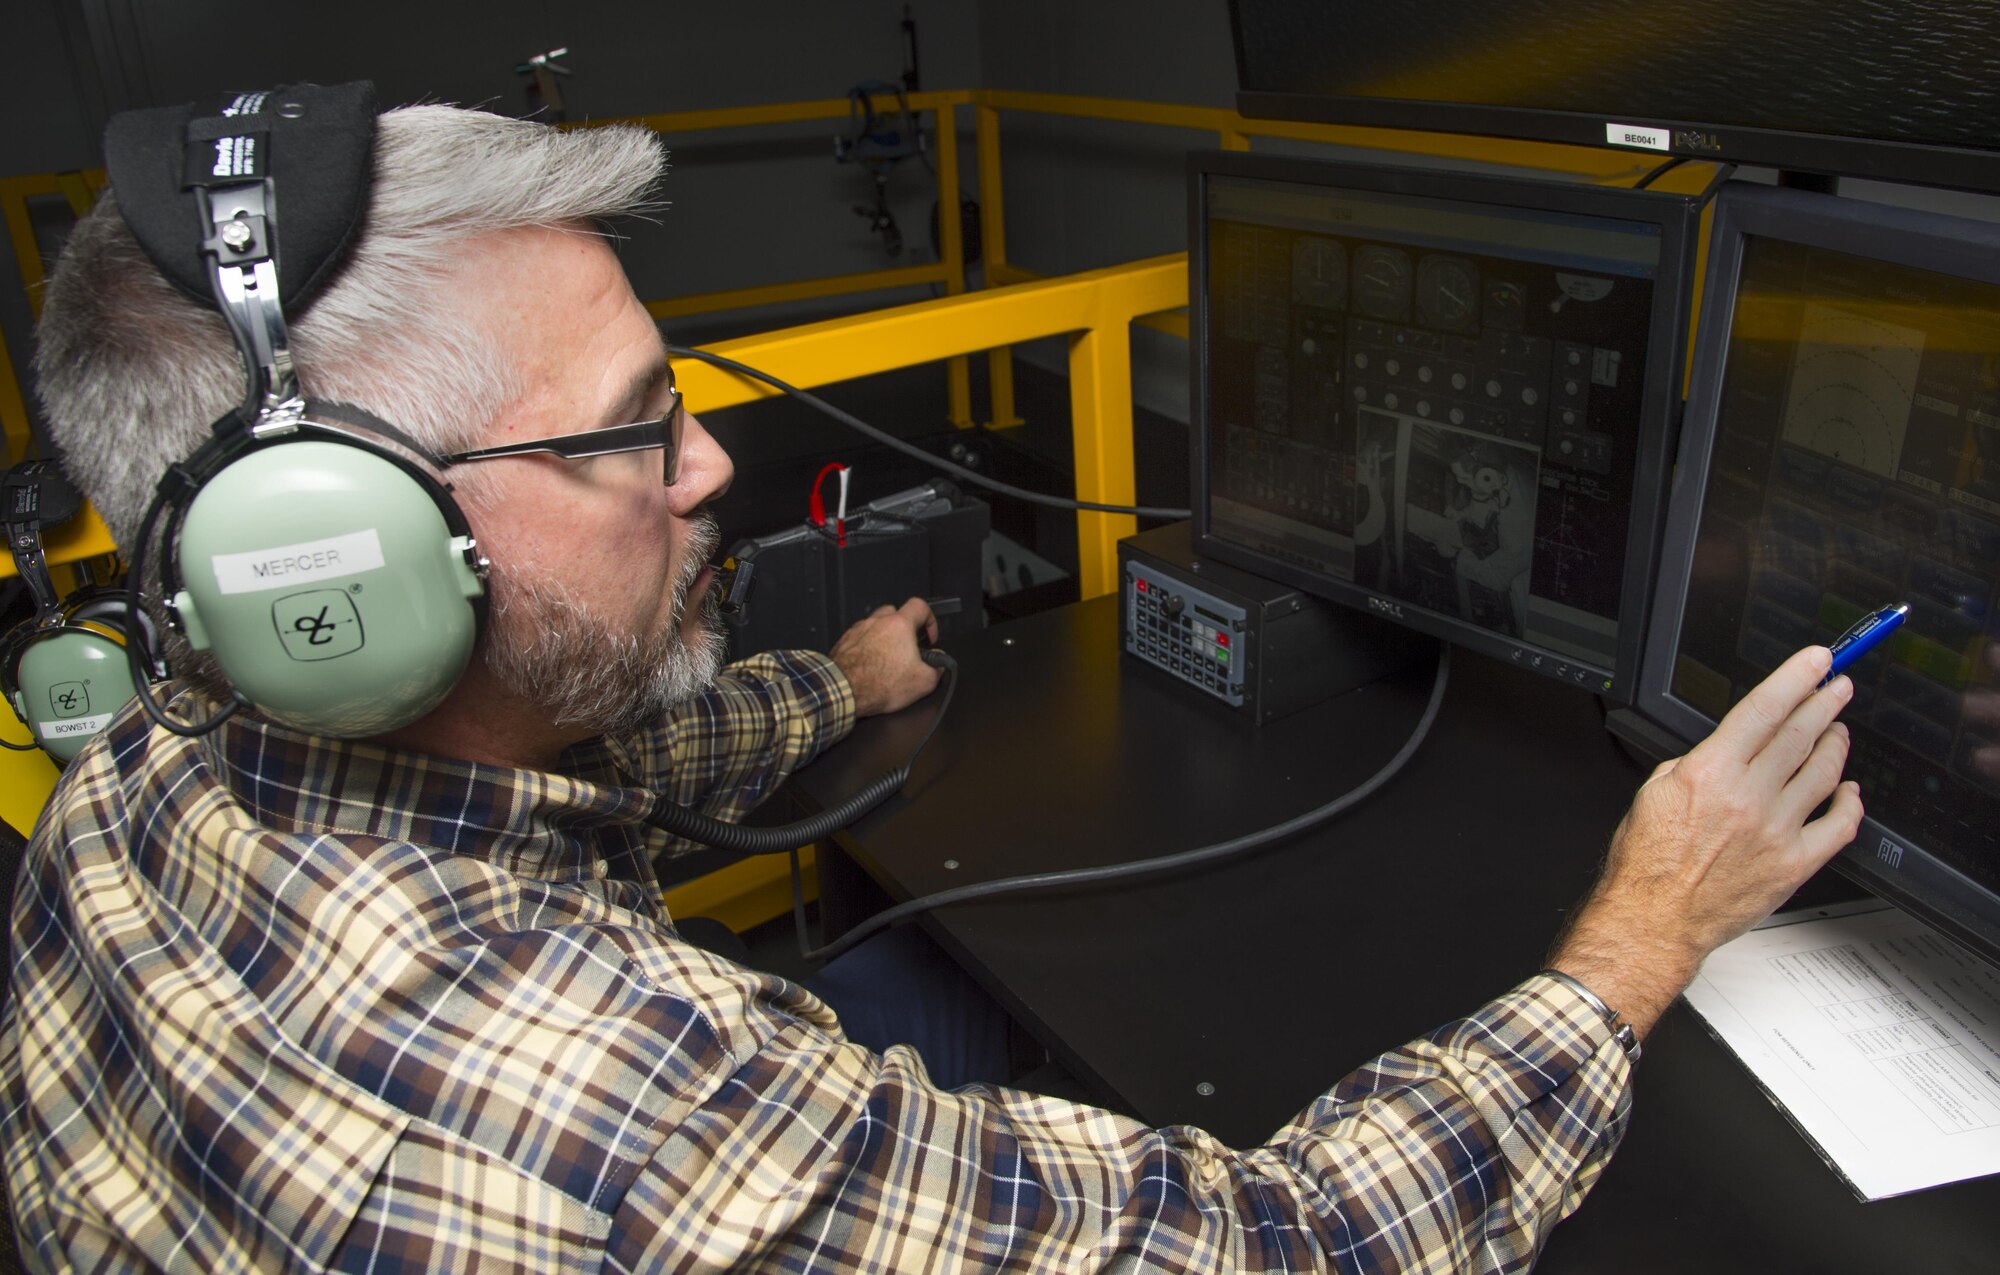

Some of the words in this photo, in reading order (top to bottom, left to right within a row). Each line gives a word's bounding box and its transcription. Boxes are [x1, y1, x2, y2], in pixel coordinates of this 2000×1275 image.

[1624, 133, 1656, 146] BE0041
[252, 550, 341, 578] MERCER
[1368, 596, 1404, 619] DELL
[55, 723, 87, 733] BOWST
[90, 721, 96, 729] 2
[1932, 1024, 1950, 1039] Contact
